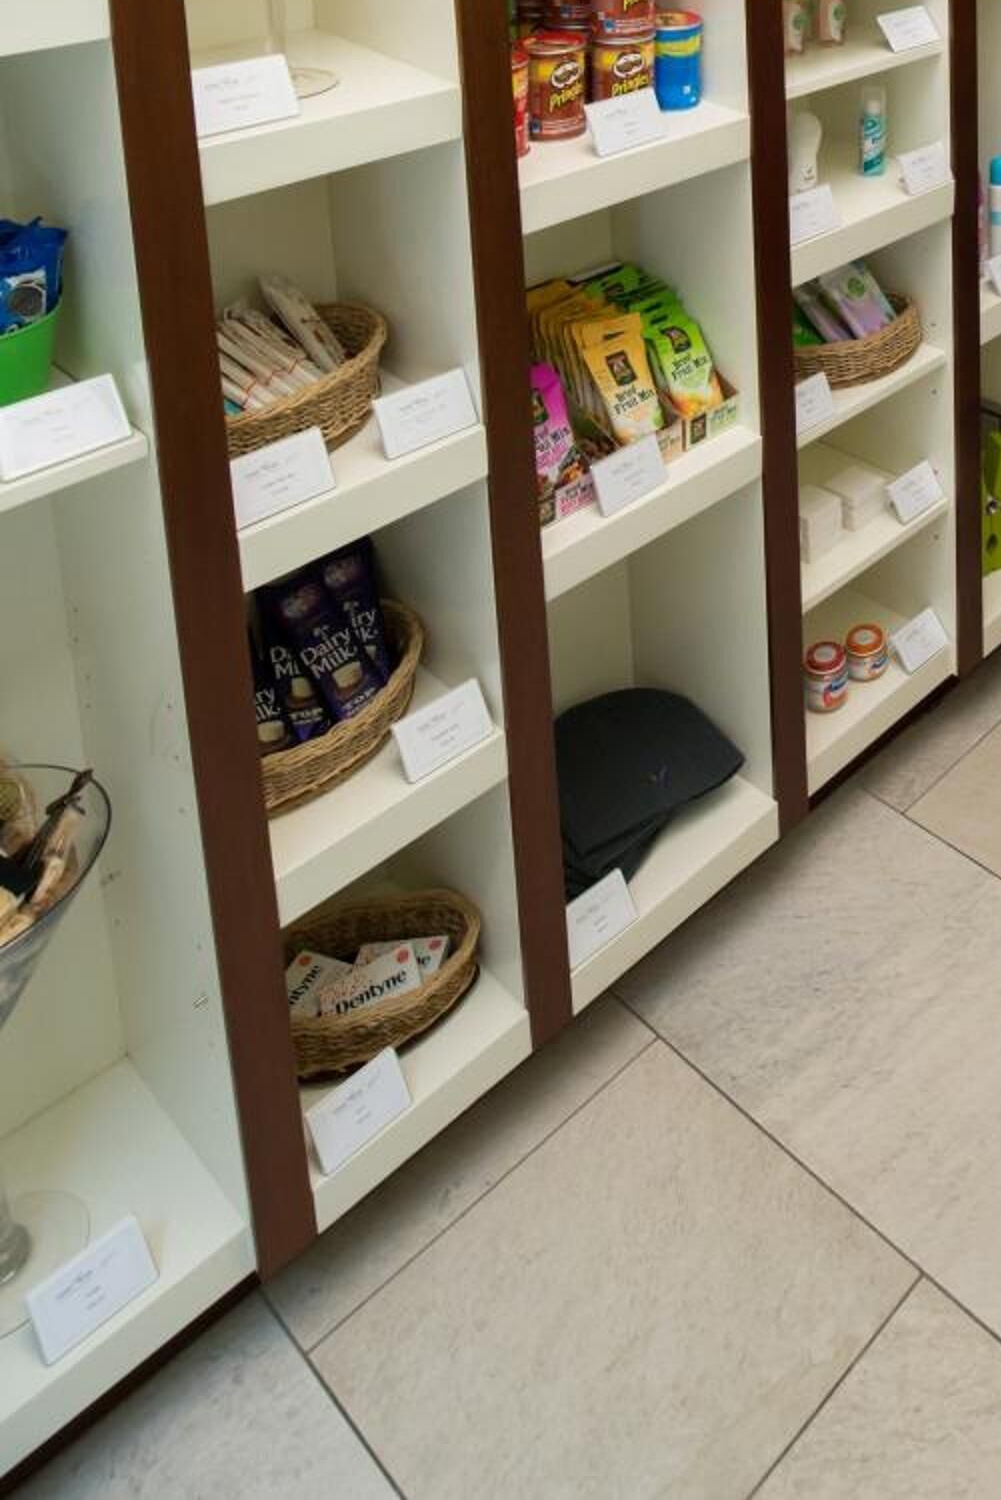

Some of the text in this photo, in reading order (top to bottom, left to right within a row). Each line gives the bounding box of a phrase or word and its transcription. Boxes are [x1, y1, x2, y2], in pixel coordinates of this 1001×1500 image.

[549, 82, 584, 112] Pringle
[299, 628, 351, 668] Dairy
[309, 646, 358, 680] Milk
[289, 964, 322, 1005] ntyne
[334, 970, 408, 1015] Dentyne
